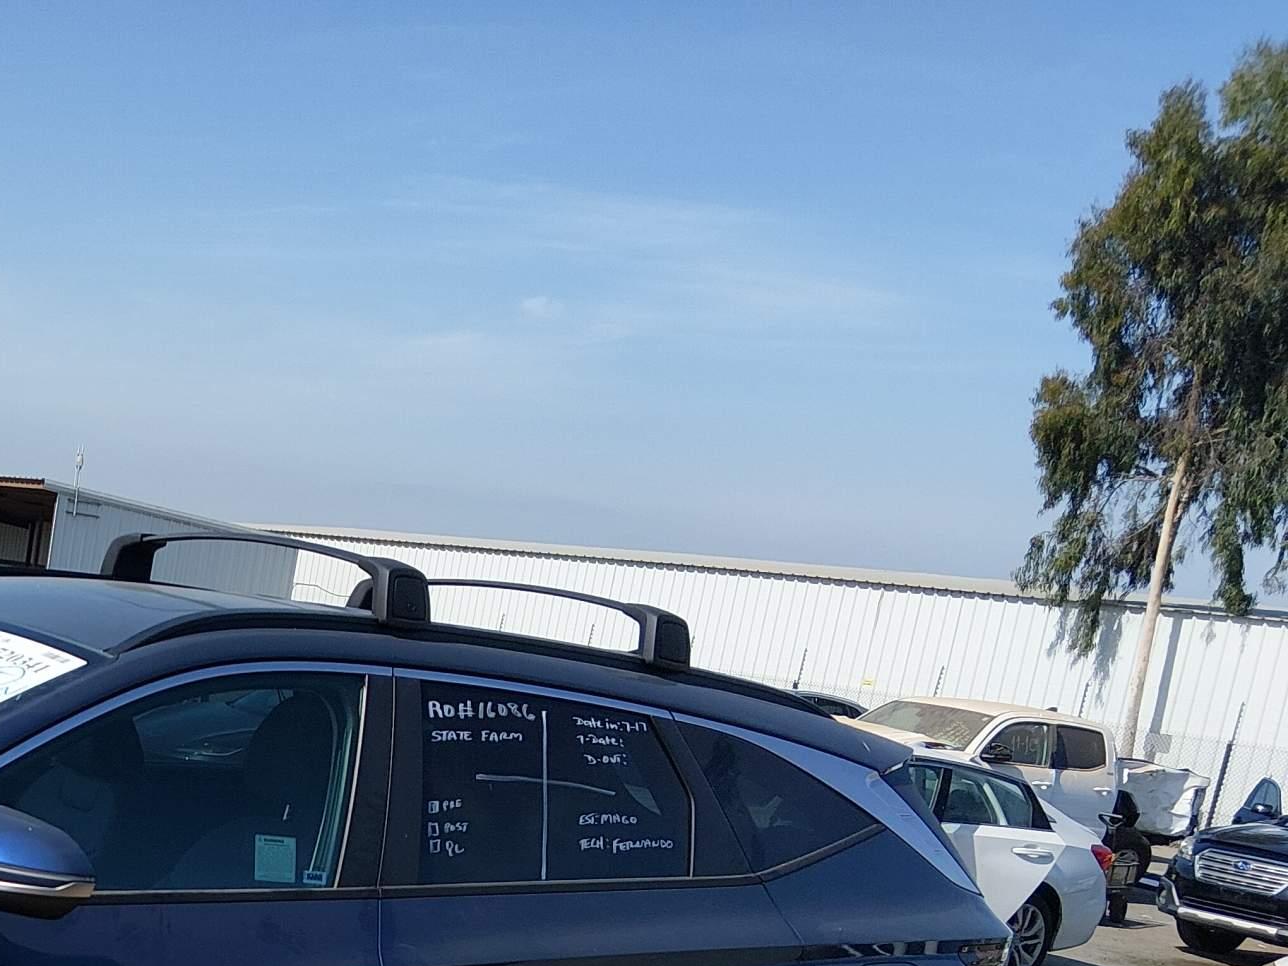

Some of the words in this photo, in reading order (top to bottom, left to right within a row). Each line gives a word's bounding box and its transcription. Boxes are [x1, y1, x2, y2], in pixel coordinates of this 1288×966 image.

[431, 730, 472, 742] STATE
[481, 730, 523, 742] FARM
[443, 822, 470, 833] POST
